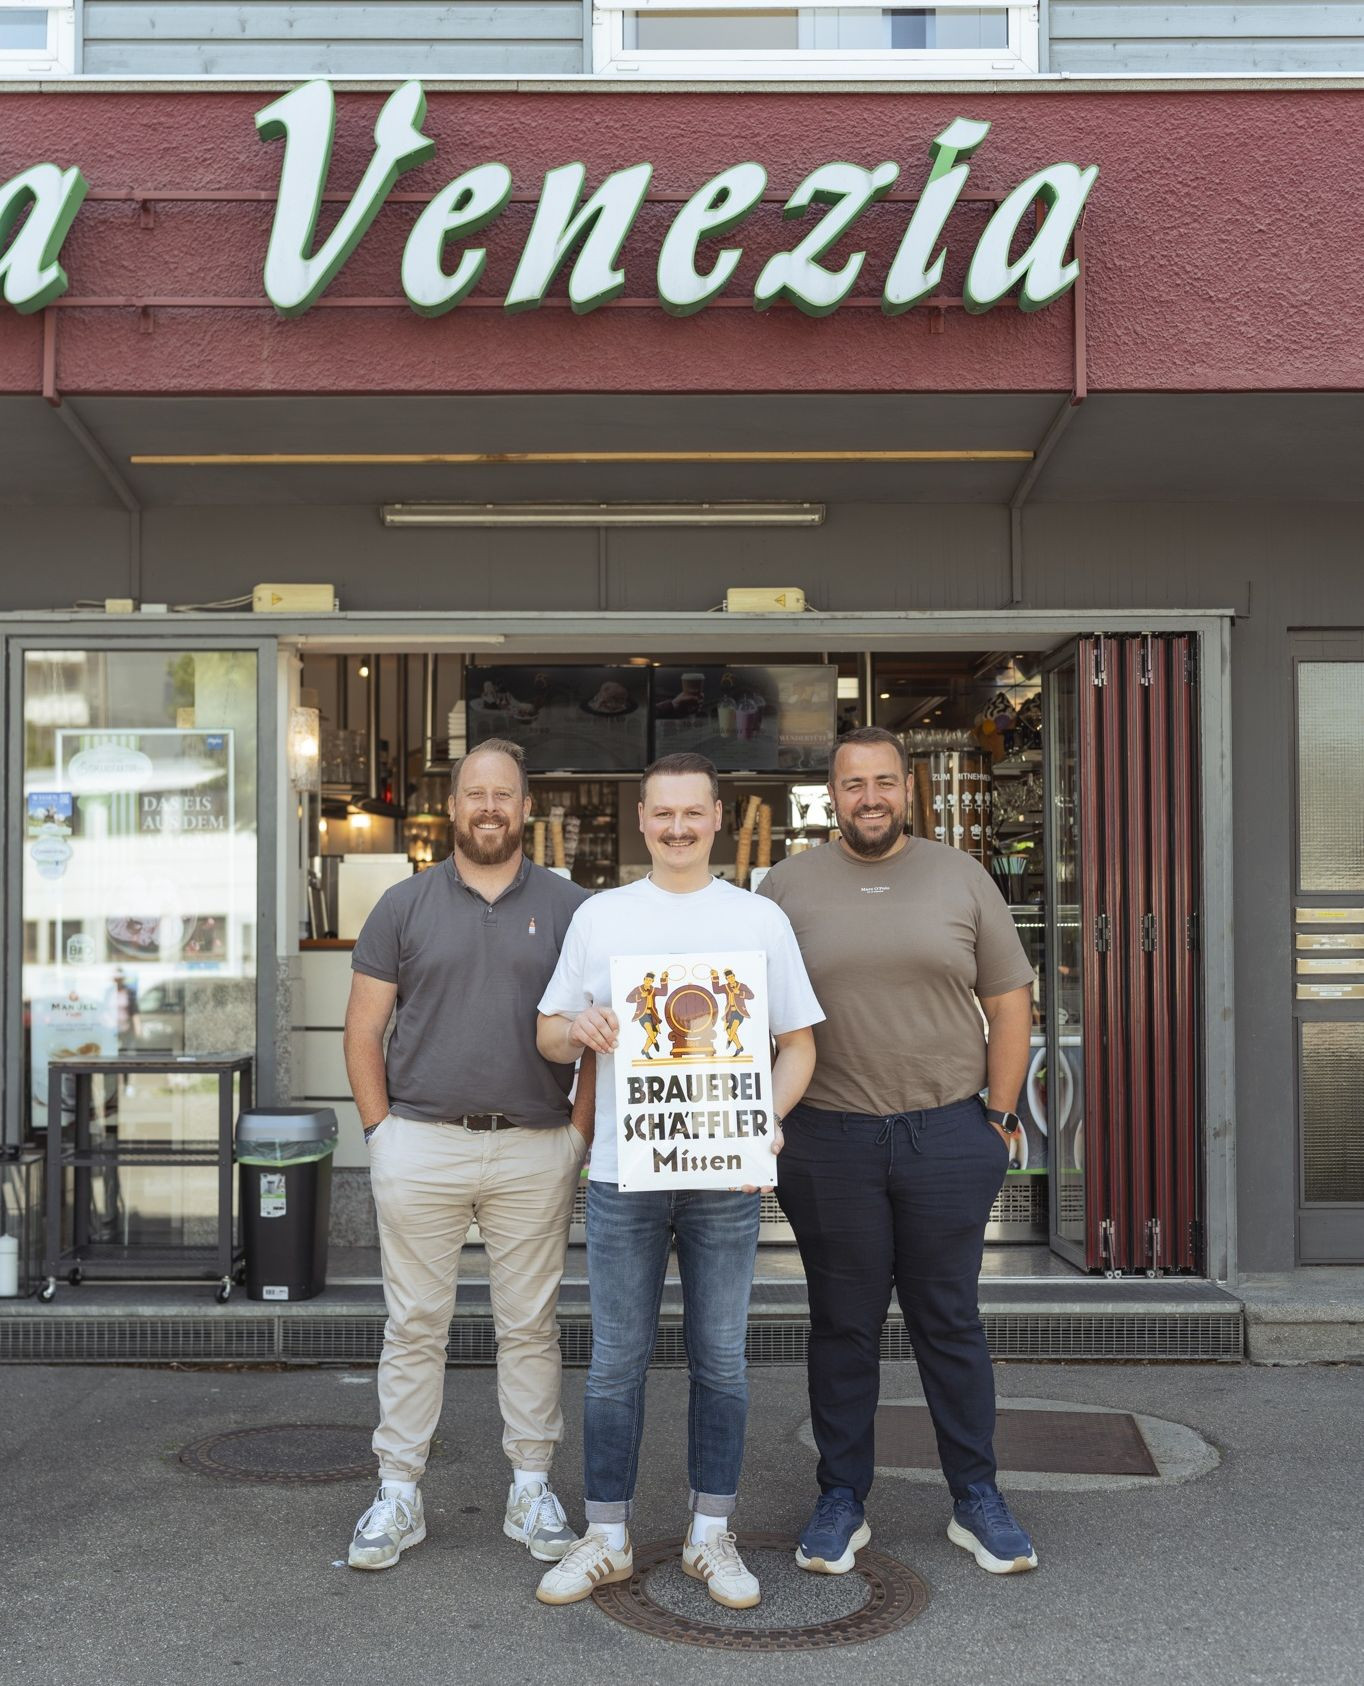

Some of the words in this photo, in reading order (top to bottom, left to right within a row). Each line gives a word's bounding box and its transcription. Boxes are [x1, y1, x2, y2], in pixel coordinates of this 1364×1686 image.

[254, 78, 1101, 317] Venezia
[932, 773, 950, 781] ZUM
[143, 796, 181, 811] DAS
[184, 796, 211, 811] EIS
[143, 815, 181, 830] AUS
[184, 815, 224, 829] DEM
[627, 1072, 762, 1105] BRAUEREI
[624, 1109, 768, 1142] SCHÄFFLER
[653, 1146, 742, 1173] Missen
